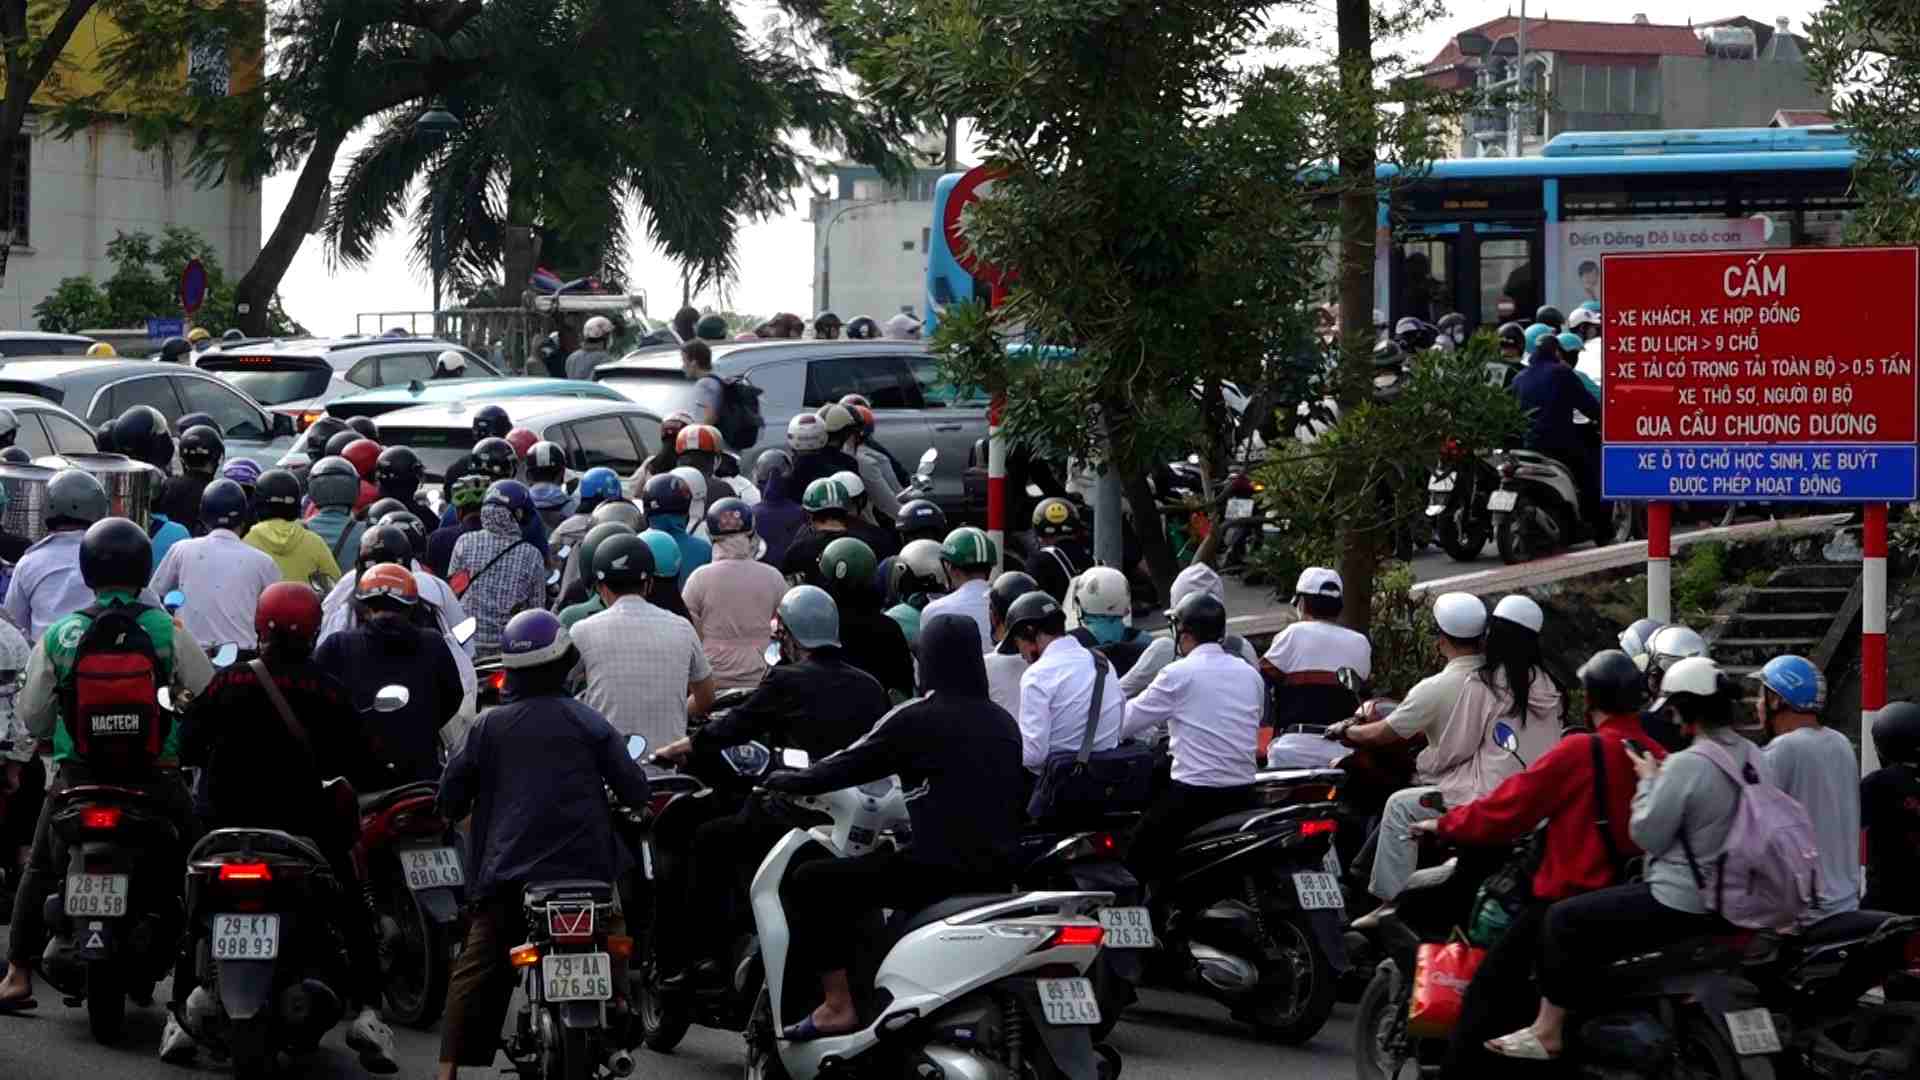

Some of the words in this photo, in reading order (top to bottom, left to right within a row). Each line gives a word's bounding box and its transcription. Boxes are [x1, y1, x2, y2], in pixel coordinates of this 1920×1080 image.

[1723, 251, 1787, 297] CẤM
[1700, 308, 1719, 325] XE
[1724, 305, 1754, 327] HỢP
[1641, 335, 1661, 352] DU
[1665, 335, 1697, 356] LỊCH
[1715, 335, 1724, 351] 9
[1641, 355, 1663, 378] TẢI
[1666, 355, 1686, 378] CÓ
[1691, 359, 1739, 382] TRỌNG
[1744, 353, 1766, 377] TẢI
[1771, 355, 1810, 377] TOÀN
[1815, 355, 1836, 379] BỘ
[1852, 358, 1874, 377] 0,5
[1880, 351, 1911, 375] TẤN
[1678, 388, 1697, 405] XE
[1702, 383, 1731, 405] THÔ
[1764, 382, 1808, 405] NGƯỜI
[1812, 386, 1827, 405] ĐI
[1832, 383, 1853, 406] BỘ
[1635, 415, 1673, 437] QUA
[1679, 406, 1717, 437] CẦU
[1724, 412, 1801, 436] CHƯƠNG
[1809, 411, 1877, 436] DƯƠNG
[1638, 452, 1657, 470] XE
[1662, 447, 1672, 469] Ô
[1678, 447, 1697, 470] TÔ
[1700, 448, 1730, 470] CHỞ
[1734, 452, 1765, 474] HỌC
[1812, 451, 1831, 470] XE
[1838, 448, 1879, 470] BUÝT
[1669, 474, 1708, 497] ĐƯỢC
[1713, 471, 1751, 494] PHÉP
[1756, 476, 1794, 496] HOẠT
[1800, 473, 1841, 497] ĐỘNG
[217, 937, 274, 956] 988.93
